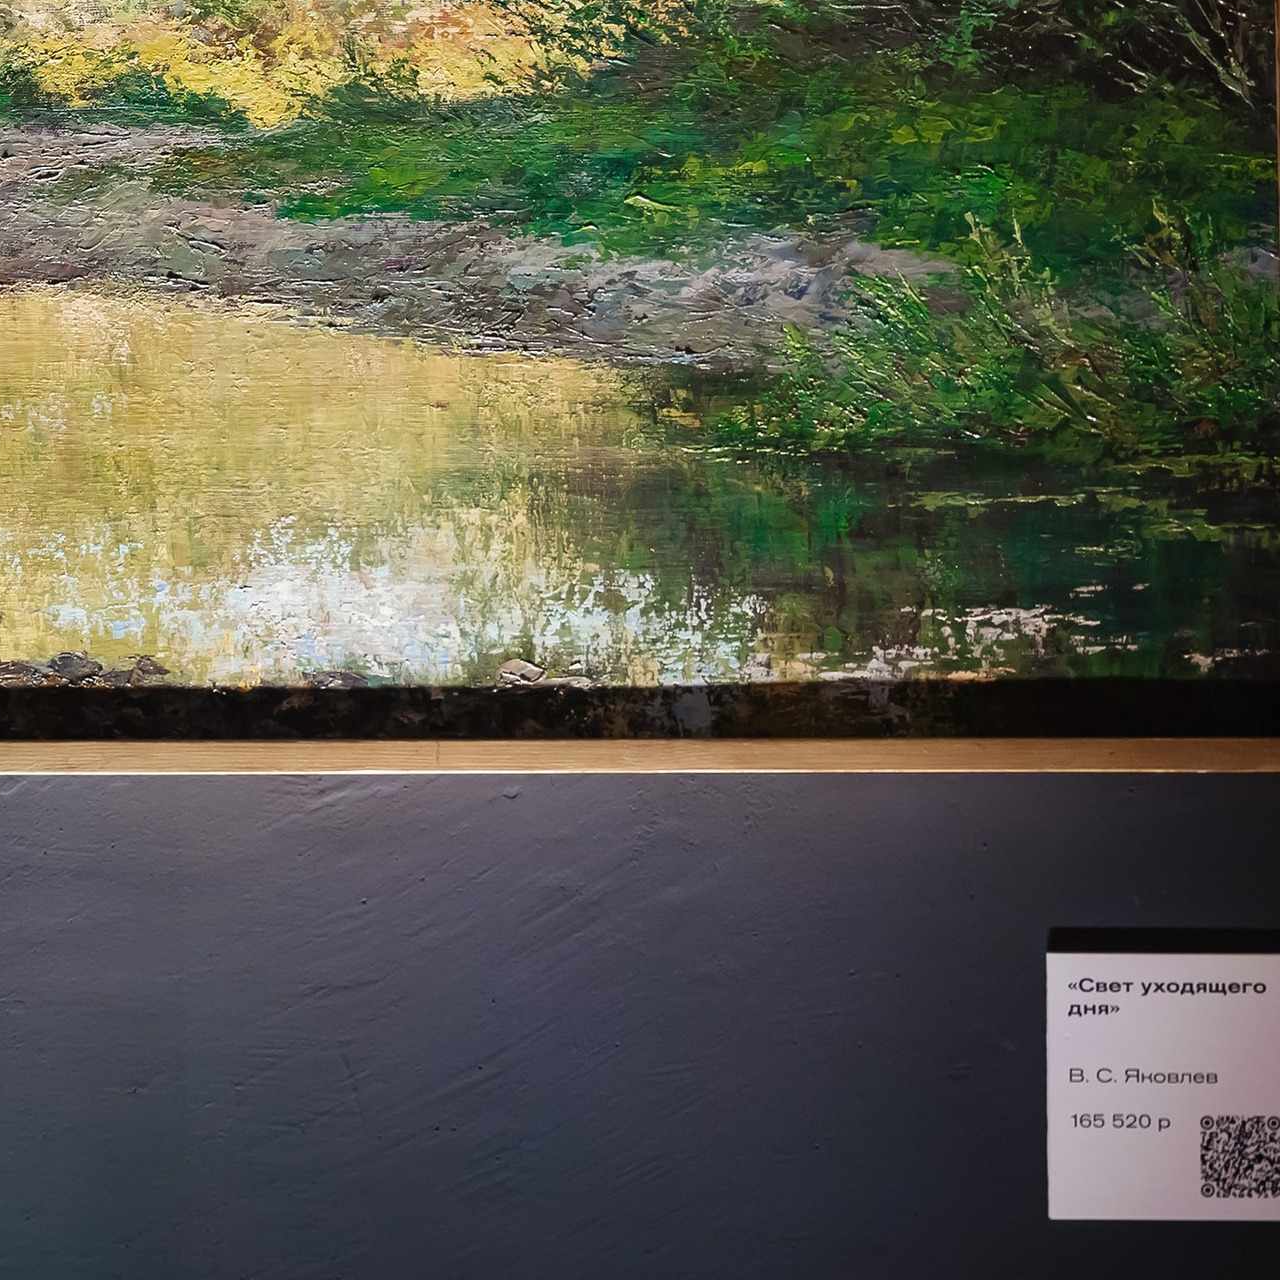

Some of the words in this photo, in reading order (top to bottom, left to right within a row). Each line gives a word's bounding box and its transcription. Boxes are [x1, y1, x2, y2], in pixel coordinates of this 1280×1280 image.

[1068, 978, 1134, 993] «Свет
[1141, 981, 1268, 996] уходящего
[1068, 1004, 1120, 1017] дня»
[1069, 1068, 1090, 1083] В.
[1096, 1068, 1118, 1083] С.
[1124, 1068, 1219, 1084] Яковлев
[1071, 1114, 1106, 1129] 165
[1112, 1114, 1152, 1129] 520
[1158, 1117, 1172, 1132] р
